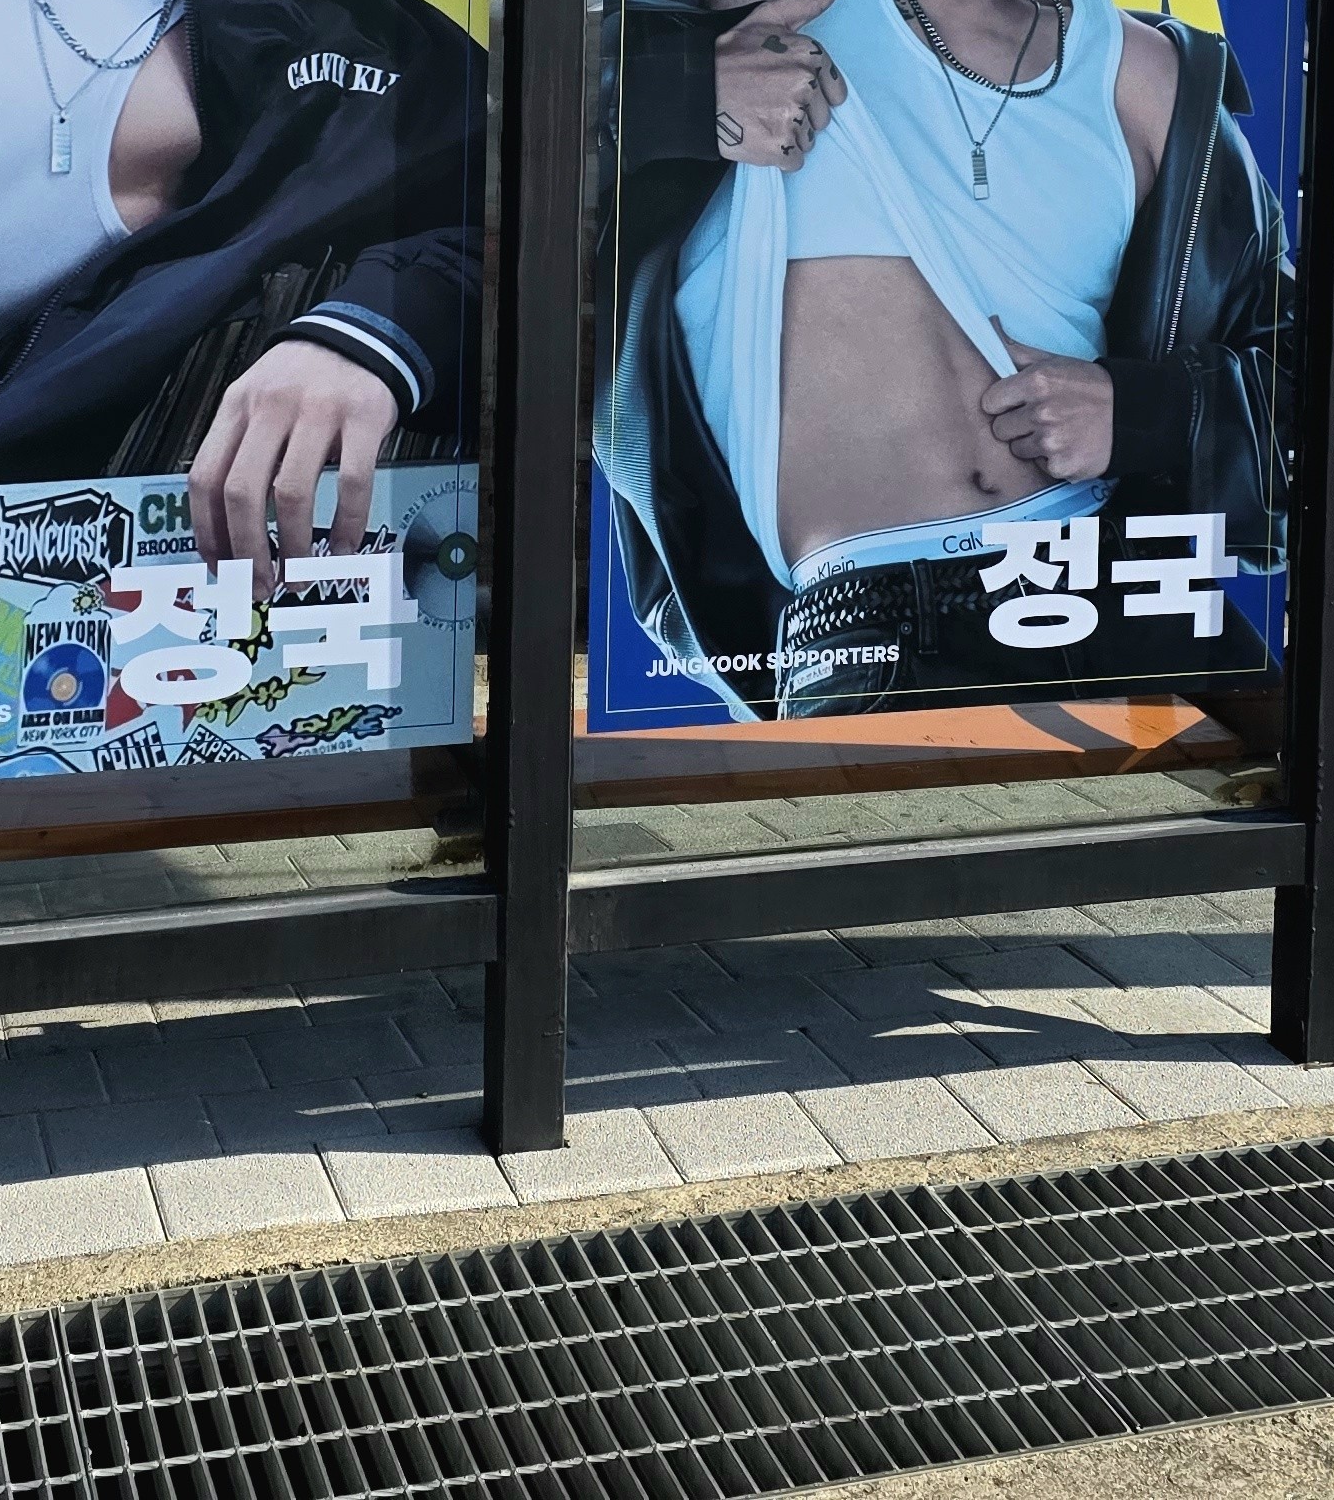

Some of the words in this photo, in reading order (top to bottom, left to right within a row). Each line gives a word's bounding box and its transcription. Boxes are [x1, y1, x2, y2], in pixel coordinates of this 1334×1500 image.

[817, 555, 856, 582] Klein
[978, 513, 1238, 649] 정국
[23, 621, 62, 668] NEW
[66, 618, 112, 666] YORK
[107, 553, 418, 706] 정국
[645, 653, 763, 678] JUNGKOOK
[766, 644, 900, 670] SUPPORTERS
